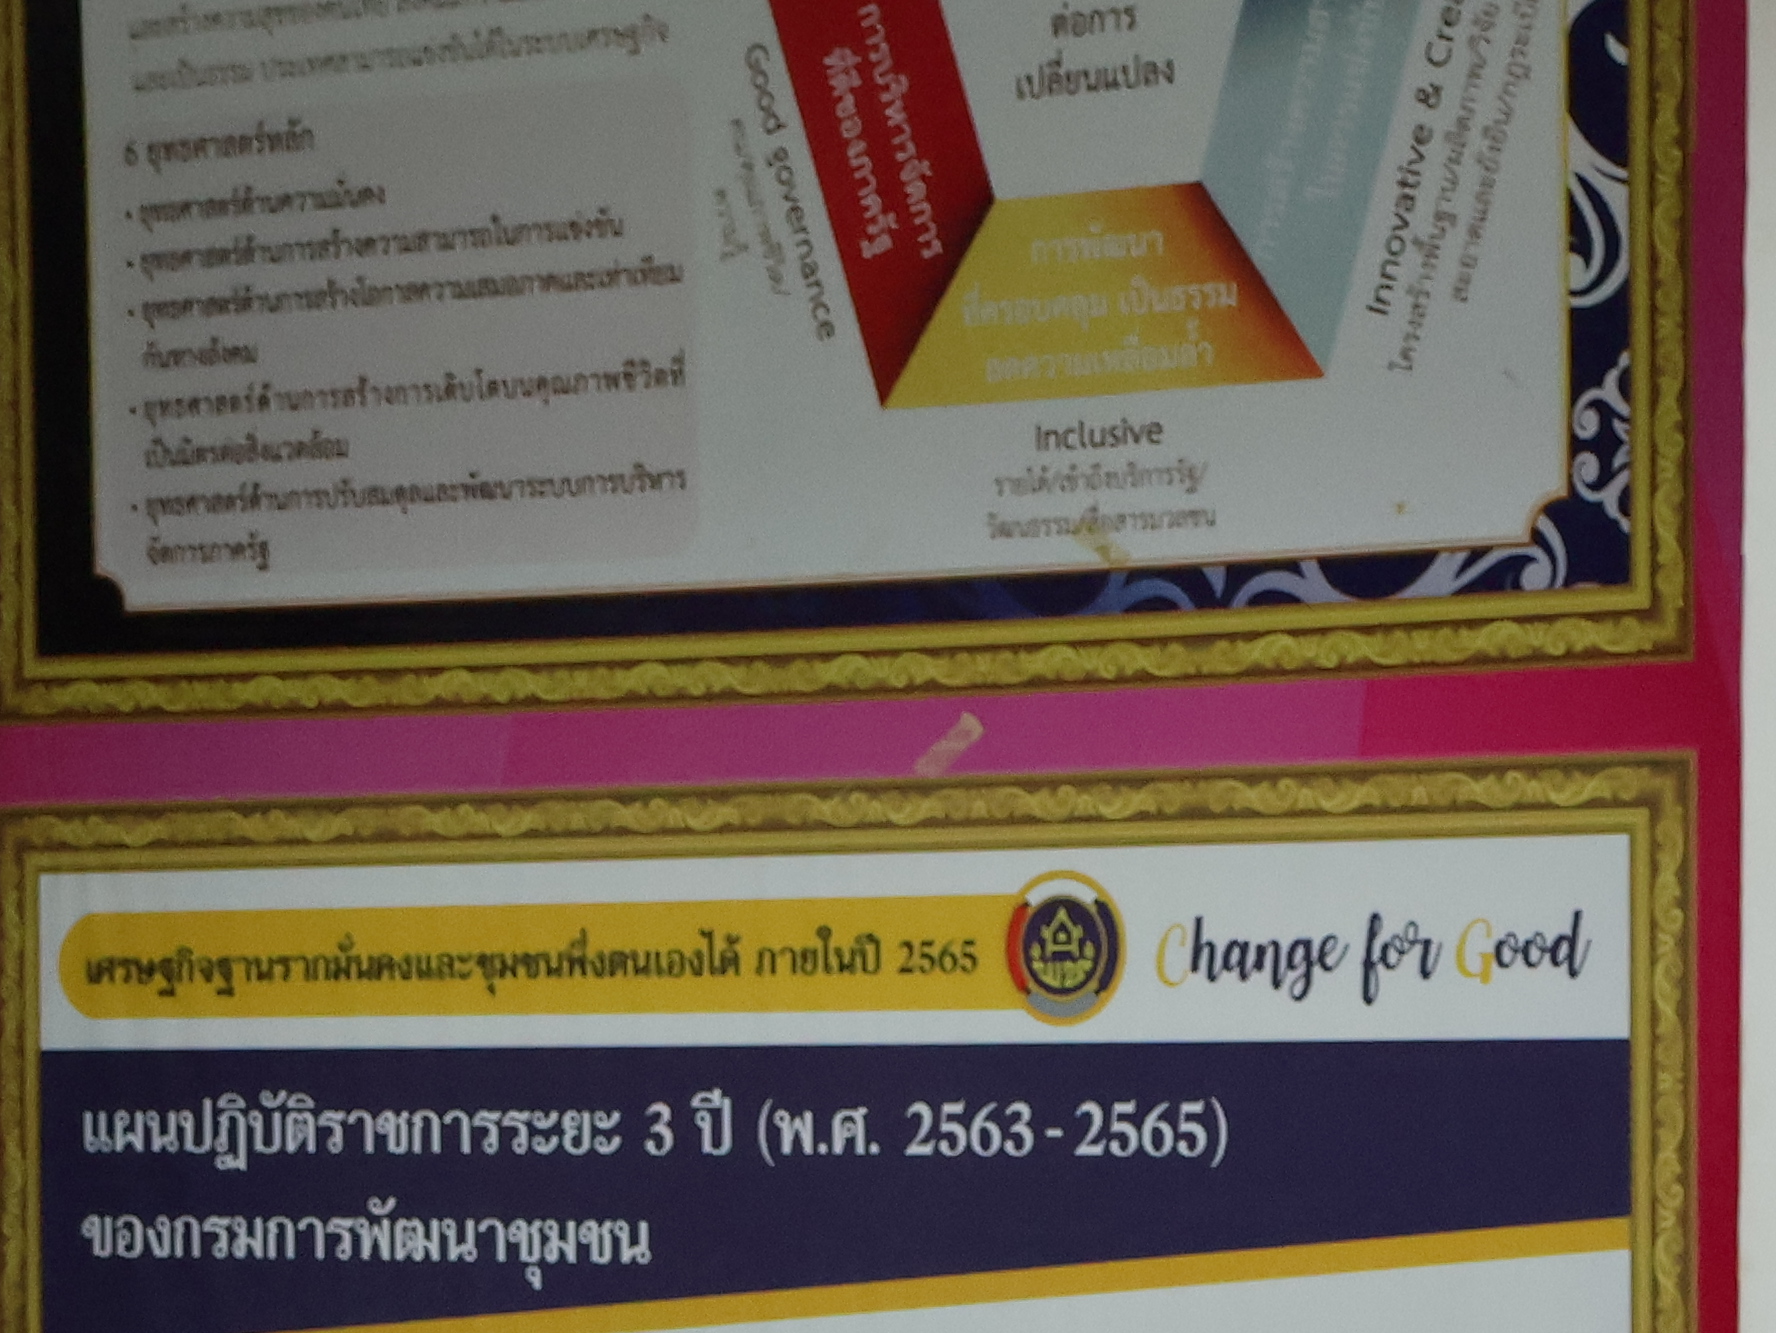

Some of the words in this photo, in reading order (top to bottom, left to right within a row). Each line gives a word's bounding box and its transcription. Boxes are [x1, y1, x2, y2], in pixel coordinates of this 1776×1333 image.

[1424, 0, 1464, 69] Cre
[744, 43, 787, 135] Good
[1413, 82, 1443, 110] &
[764, 147, 835, 341] governance
[1365, 122, 1434, 316] Innovative
[1034, 417, 1164, 451] Inclusive
[755, 924, 882, 980] ภายในปี
[898, 938, 979, 977] 2565
[1155, 915, 1351, 1002] Change
[1360, 910, 1442, 1006] for
[1455, 908, 1593, 985] Good
[81, 1088, 622, 1171] แผนปฏิบัติราชการระยะ
[643, 1101, 676, 1158] 3
[690, 1087, 735, 1156] ปี
[756, 1096, 880, 1168] (พ.ศ.
[81, 1195, 653, 1290] ของกรมการพัฒนาชุมชน
